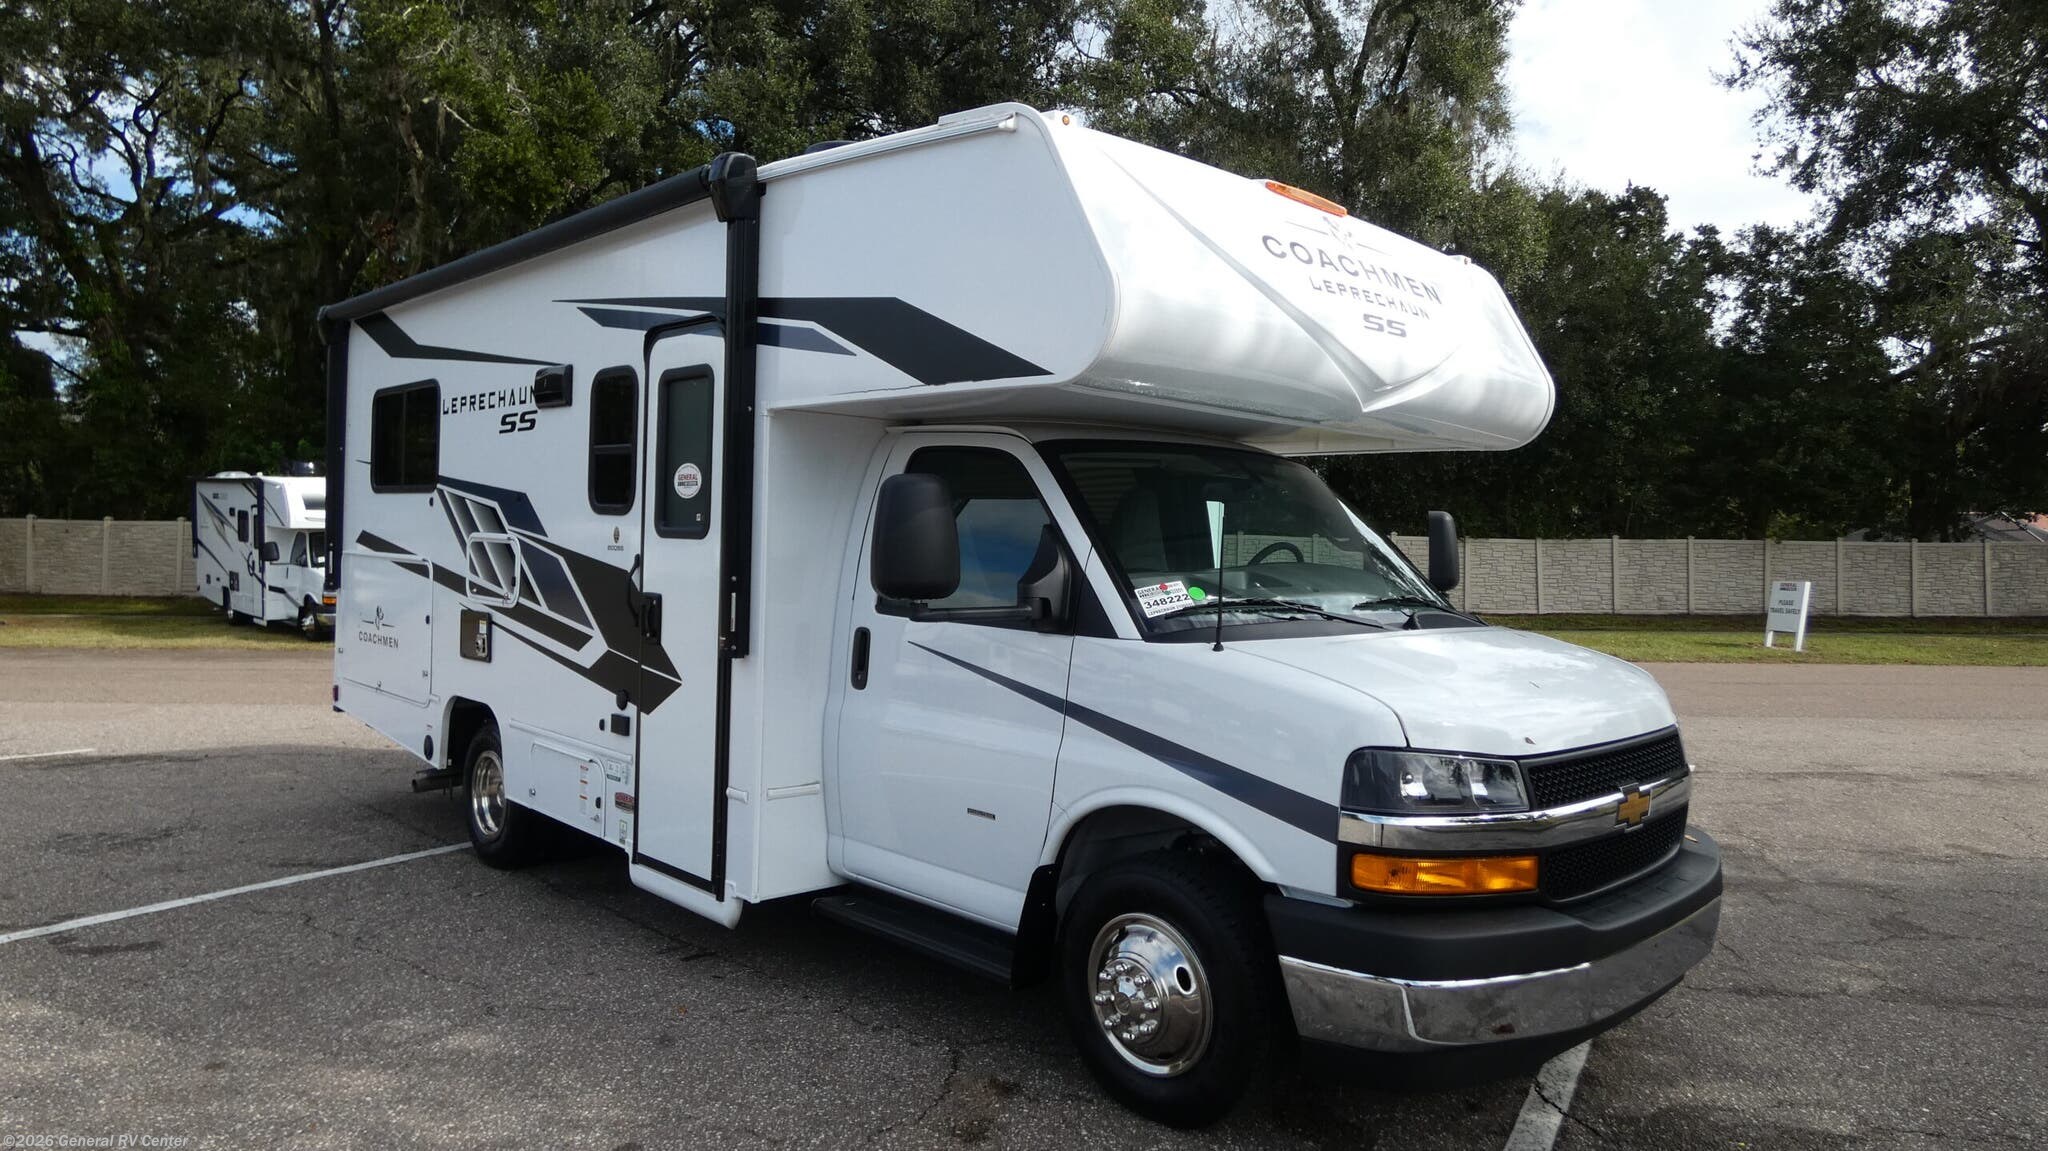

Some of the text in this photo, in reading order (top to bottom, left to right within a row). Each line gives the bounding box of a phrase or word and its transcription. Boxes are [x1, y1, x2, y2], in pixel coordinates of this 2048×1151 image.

[1261, 234, 1443, 305] COACHMEN
[1309, 275, 1430, 320] LEPRECHAUN
[1362, 313, 1408, 338] SS
[498, 409, 538, 434] SS
[677, 473, 698, 481] GENERAL
[1136, 585, 1162, 597] GENERA
[1143, 593, 1191, 609] 348222
[358, 631, 399, 649] COACHMEN
